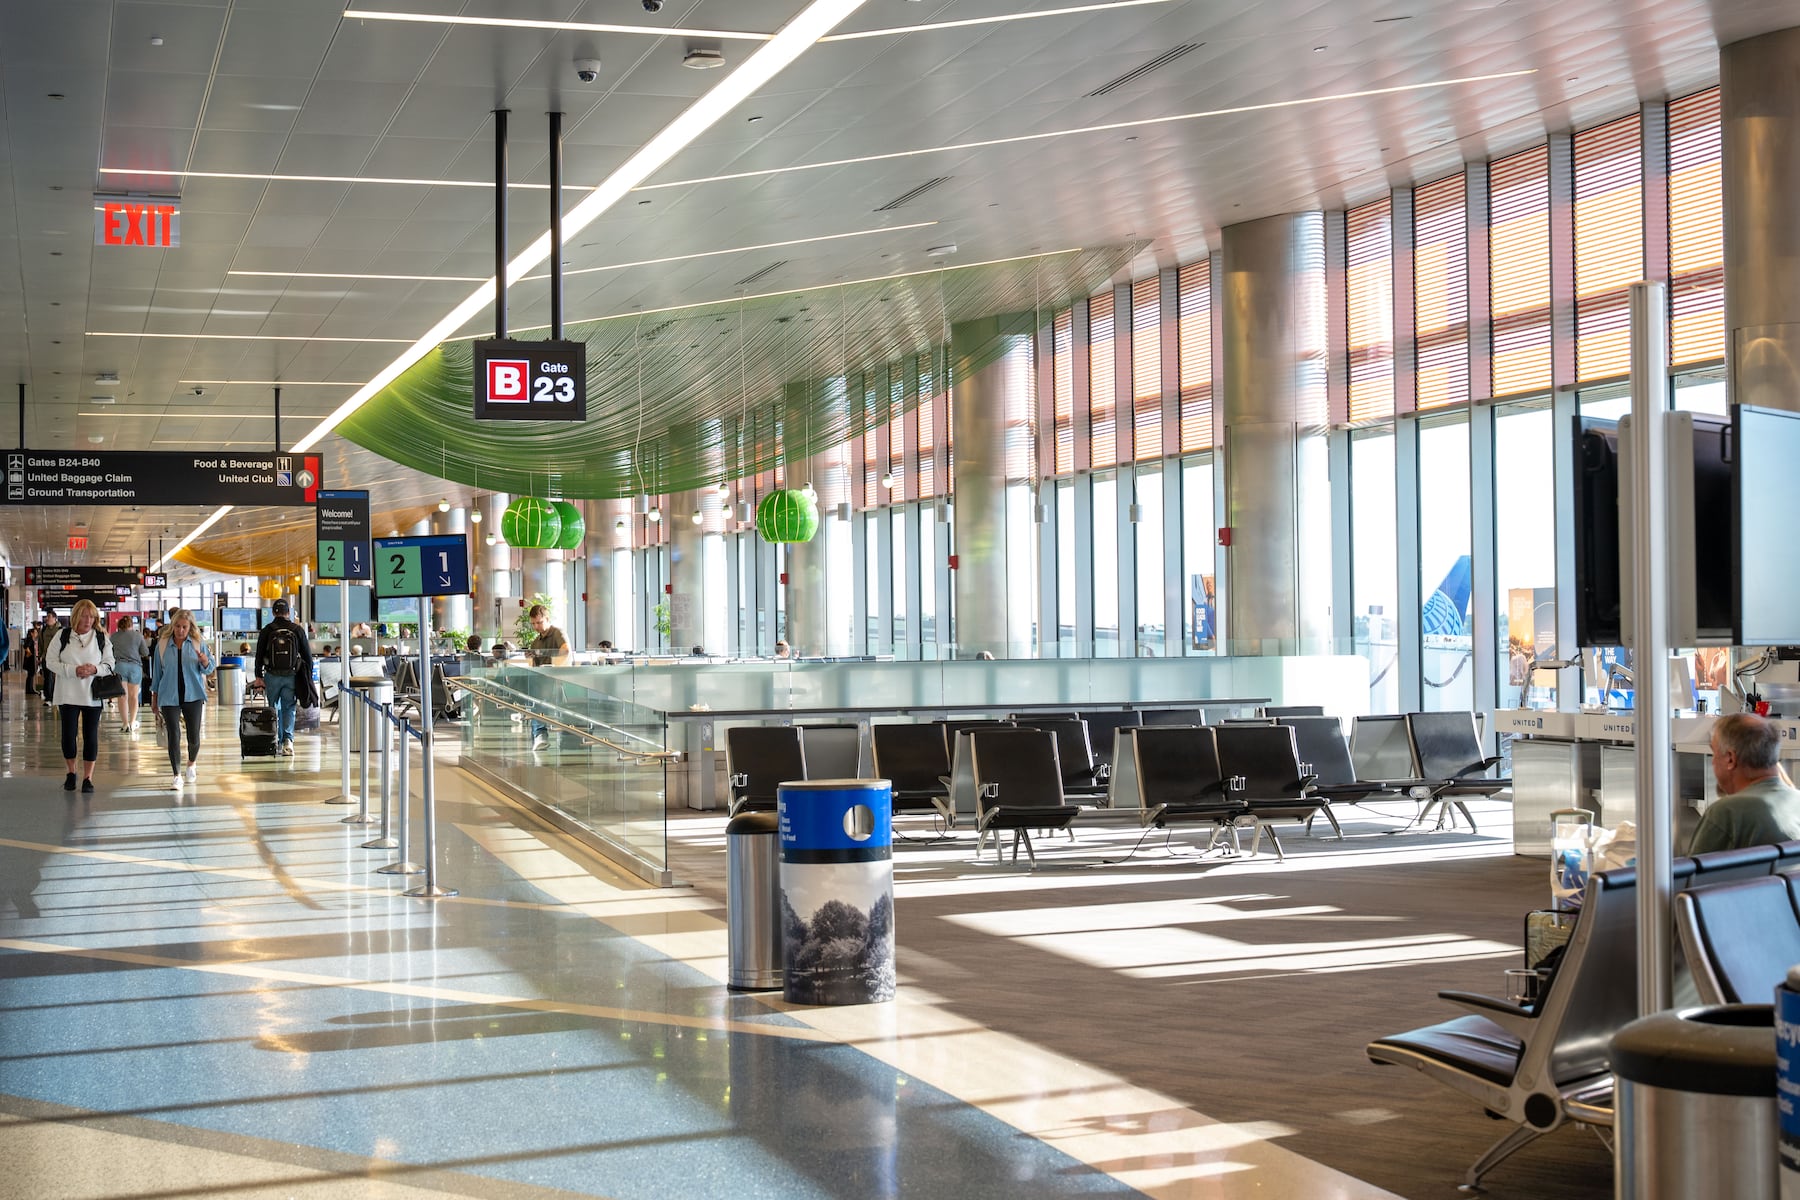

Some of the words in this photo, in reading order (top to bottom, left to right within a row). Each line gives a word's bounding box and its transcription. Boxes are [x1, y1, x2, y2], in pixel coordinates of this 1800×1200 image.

[104, 203, 175, 247] EXIT
[541, 362, 569, 373] Gate
[495, 366, 521, 396] B
[533, 376, 576, 403] 23
[27, 458, 57, 467] Gates
[58, 458, 101, 467] B24-B40
[193, 459, 218, 468] Food
[220, 460, 228, 468] &
[229, 459, 274, 470] Beverage
[27, 473, 59, 482] United
[60, 473, 103, 484] Baggage
[105, 474, 133, 483] Claim
[218, 474, 250, 483] United
[251, 474, 274, 483] Club
[27, 488, 64, 497] Ground
[66, 488, 136, 499] Transportation
[321, 509, 353, 518] Welcome!
[69, 537, 88, 549] EXIT
[327, 545, 336, 561] 2
[353, 546, 359, 562] 1
[389, 554, 406, 575] 2
[438, 551, 449, 573] 1
[1512, 719, 1537, 728] UNITED
[1603, 724, 1631, 733] UNITED
